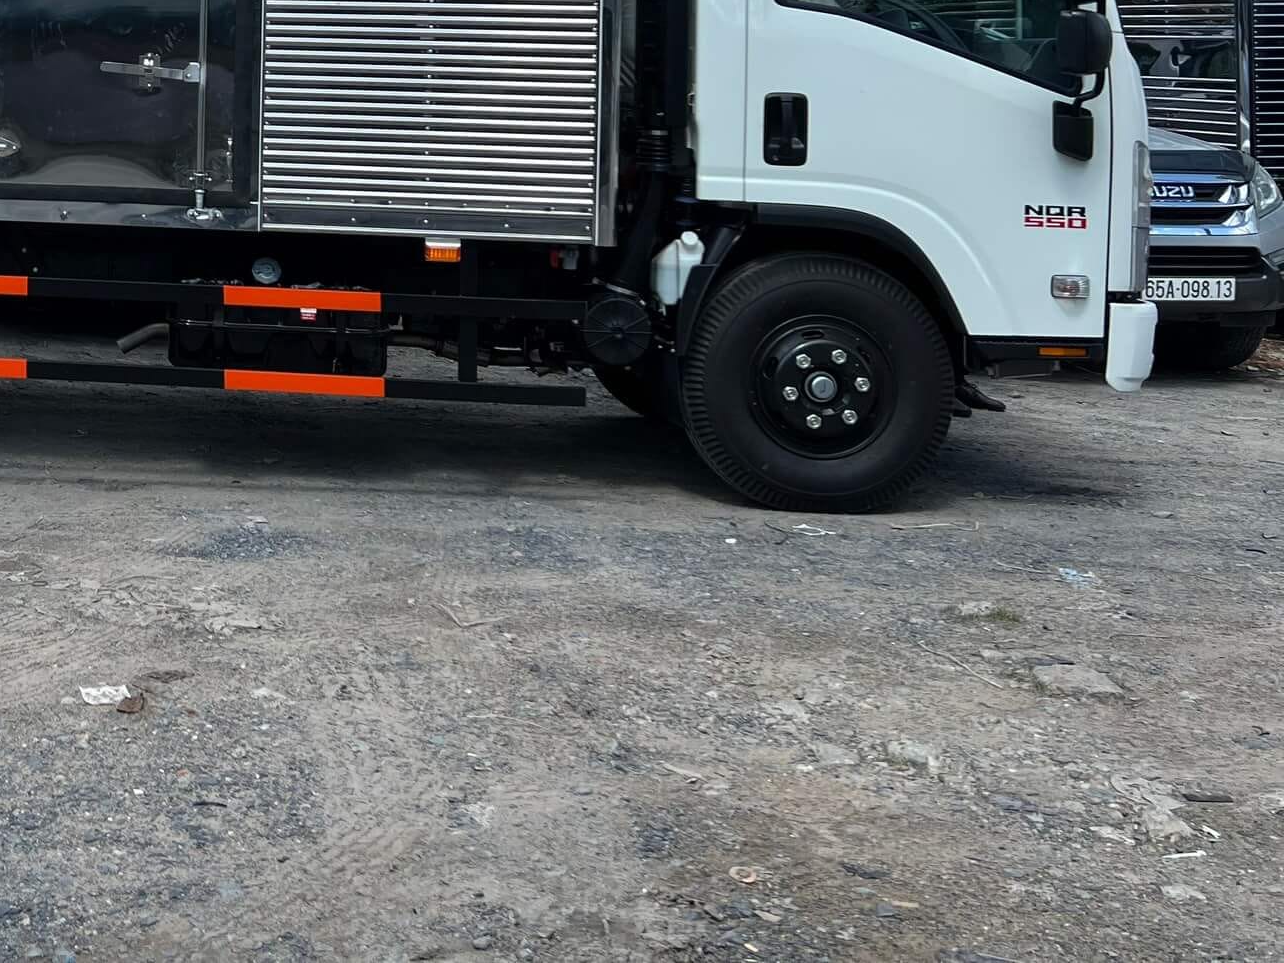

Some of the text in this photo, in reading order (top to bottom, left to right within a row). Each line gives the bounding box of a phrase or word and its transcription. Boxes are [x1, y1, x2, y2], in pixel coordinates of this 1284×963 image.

[1147, 185, 1194, 197] UZU
[1024, 204, 1086, 217] NQR
[1024, 216, 1086, 229] 550
[1145, 280, 1233, 299] 65A-098.13
